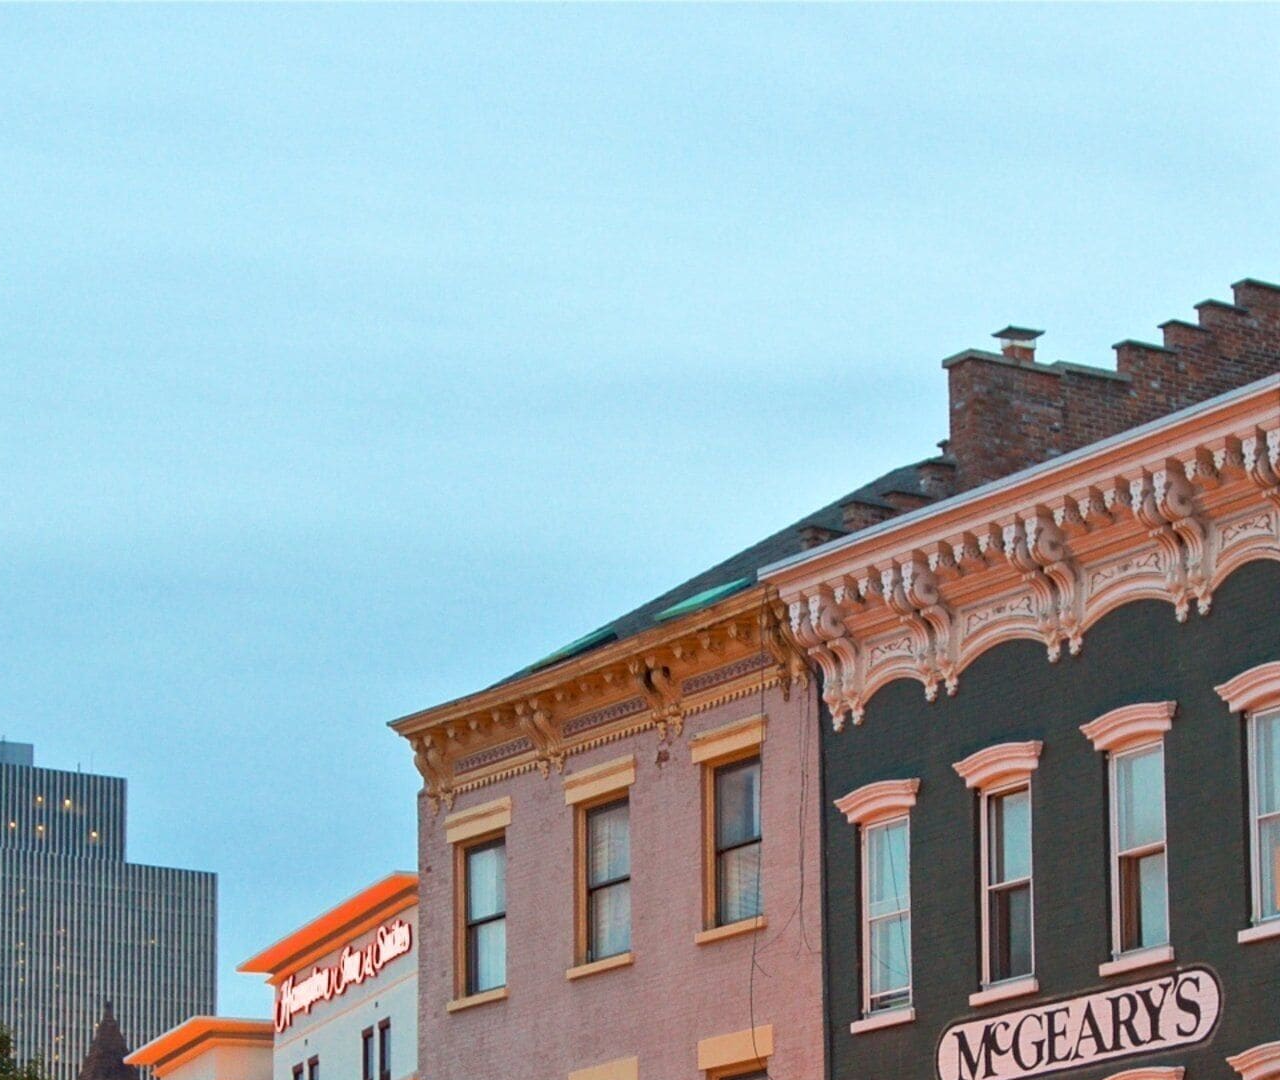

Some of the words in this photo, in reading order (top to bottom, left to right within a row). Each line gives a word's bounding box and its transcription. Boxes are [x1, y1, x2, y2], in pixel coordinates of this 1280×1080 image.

[274, 967, 337, 1032] Hampton
[334, 946, 366, 994] Inn
[374, 919, 412, 969] Suites
